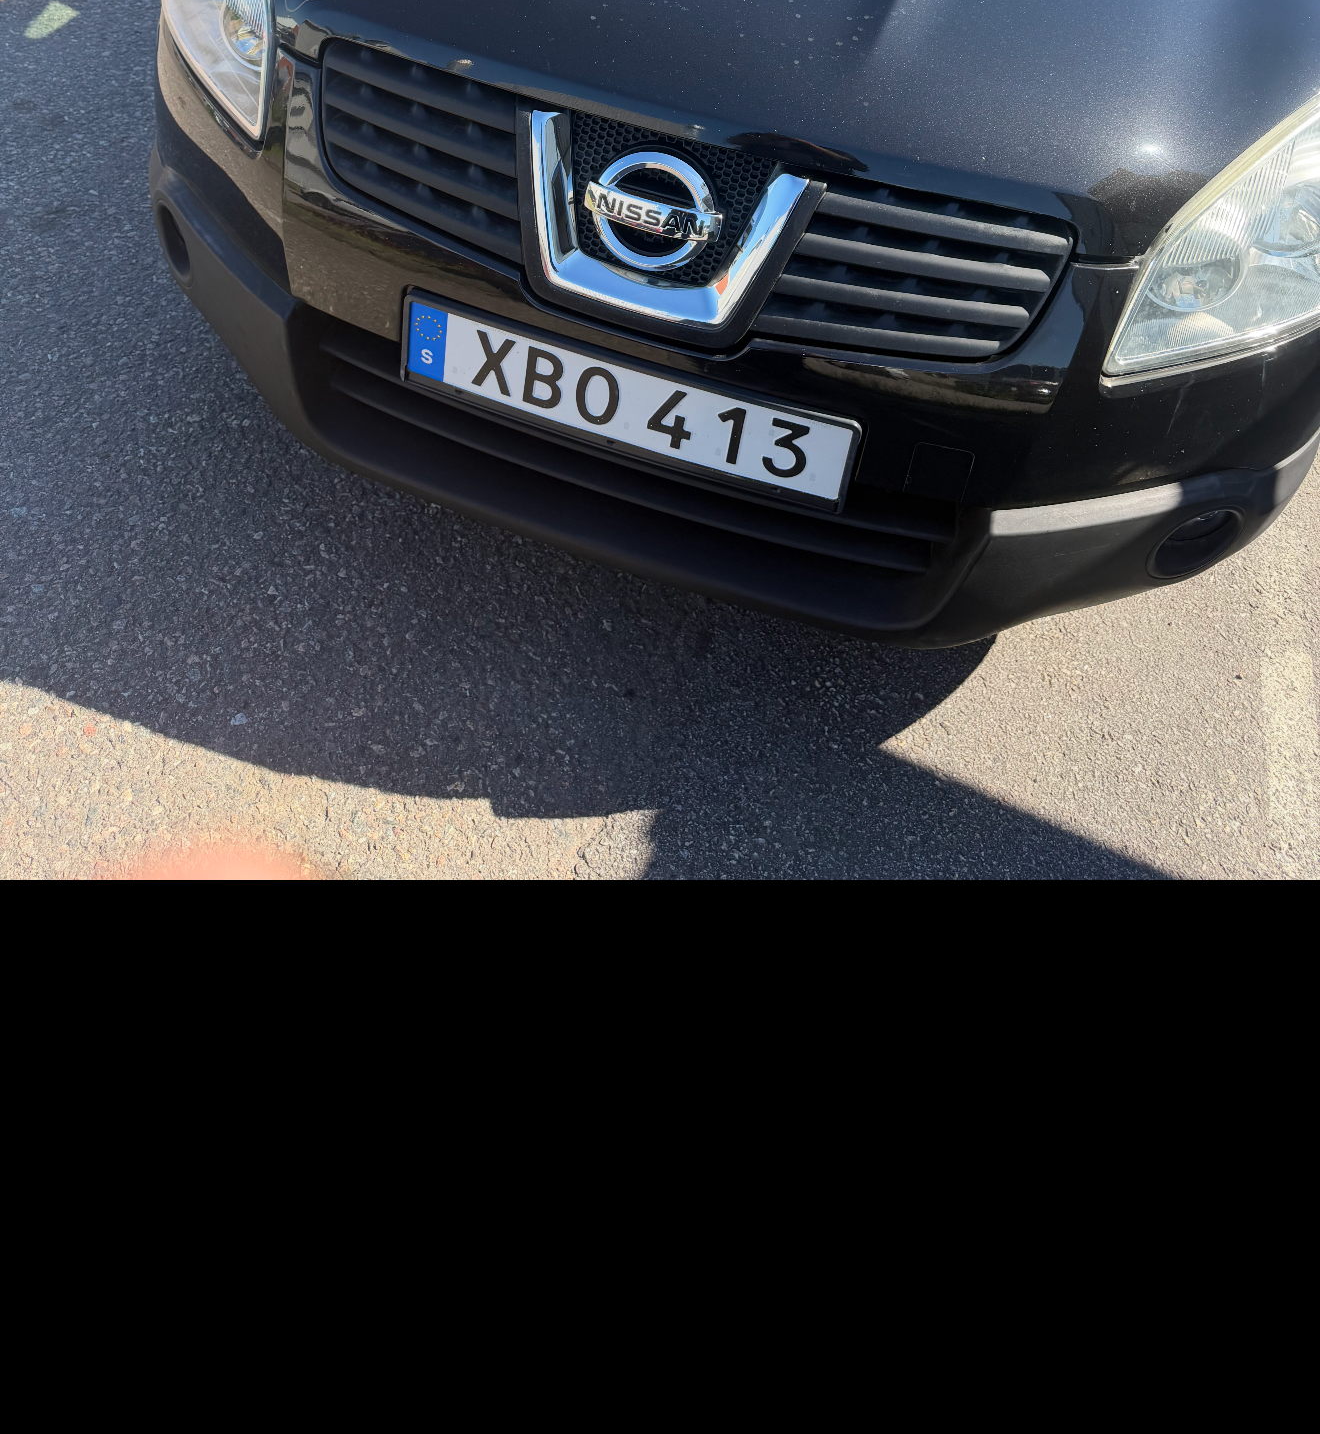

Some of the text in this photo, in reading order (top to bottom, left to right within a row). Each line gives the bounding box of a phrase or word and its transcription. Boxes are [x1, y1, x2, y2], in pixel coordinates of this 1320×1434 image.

[596, 191, 699, 237] NISSAN
[420, 348, 433, 365] S
[471, 329, 811, 479] XBO 413
